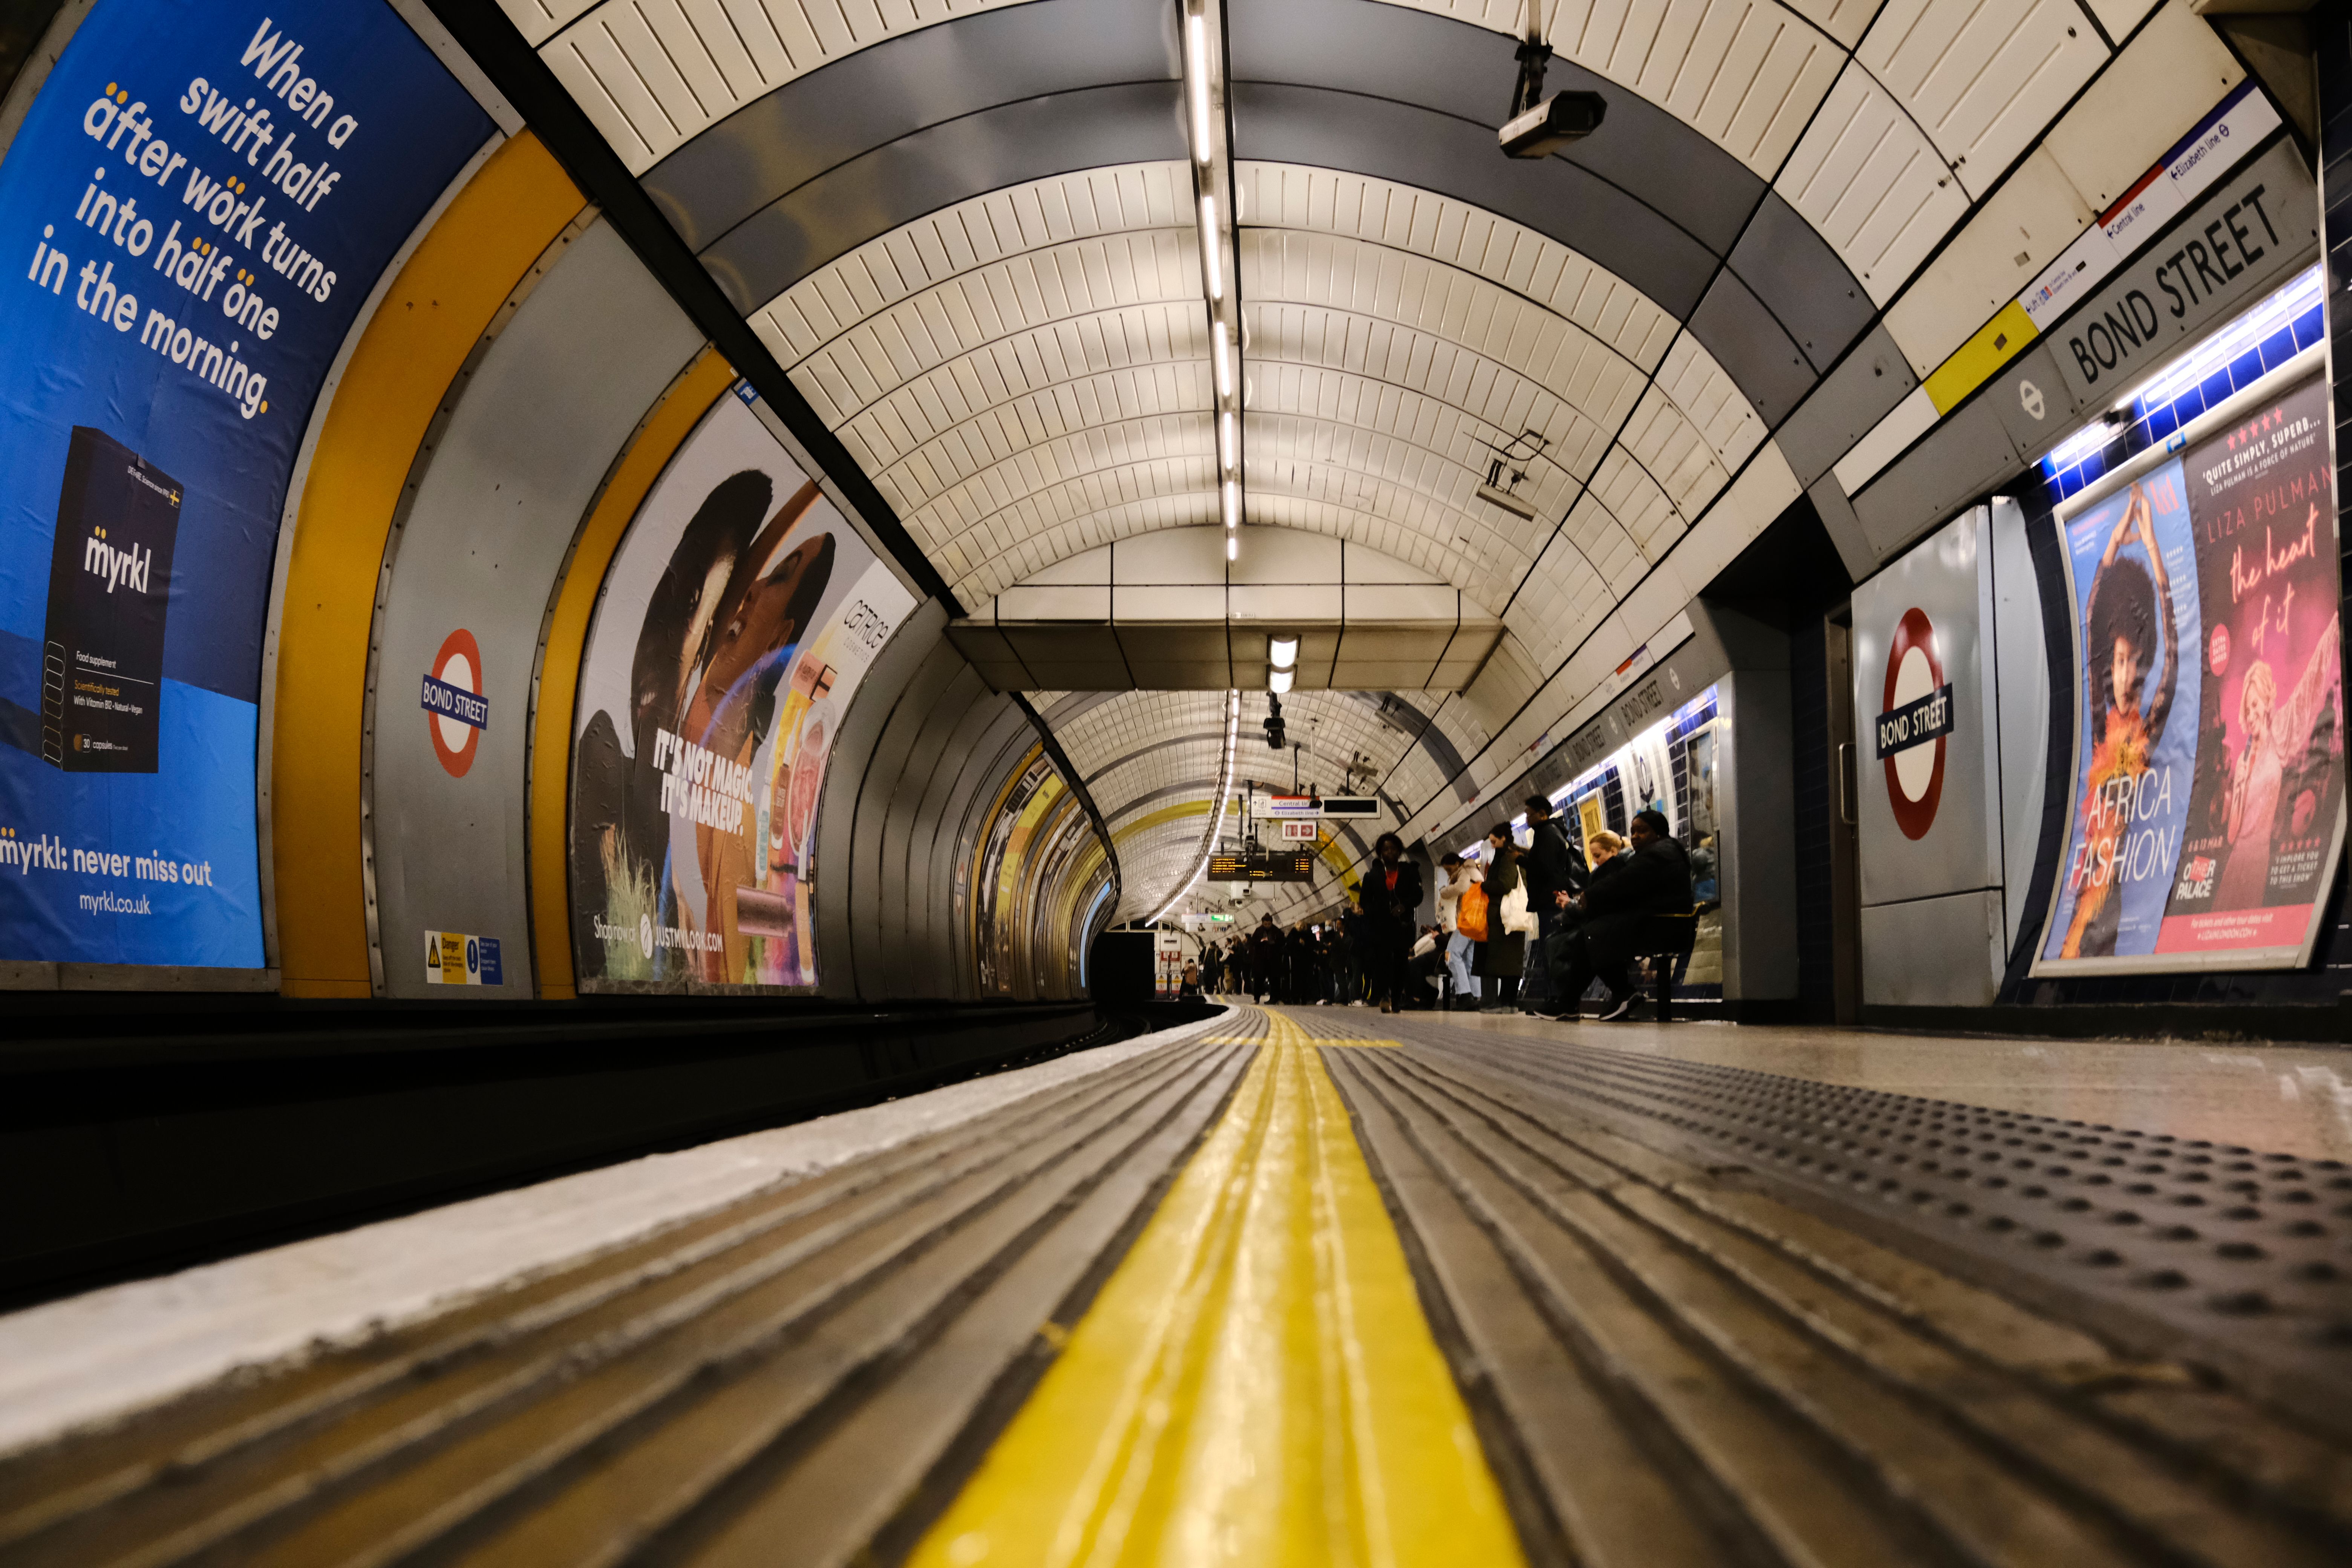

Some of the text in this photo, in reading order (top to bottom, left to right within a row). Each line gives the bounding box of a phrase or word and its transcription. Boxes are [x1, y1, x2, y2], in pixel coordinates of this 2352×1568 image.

[240, 17, 358, 149] When a
[180, 78, 341, 212] swift half
[2176, 135, 2220, 176] Elizabeth line
[75, 167, 153, 256] into
[2112, 203, 2145, 234] Central line
[262, 221, 337, 303] turns
[2069, 184, 2280, 384] BOND STREET
[28, 224, 268, 420] in the morning.
[2234, 439, 2270, 469] SIMPLY,
[2271, 417, 2320, 449] SUPERB...
[2211, 484, 2223, 496] LIZA
[2224, 470, 2245, 489] PULMAN
[2247, 466, 2252, 477] IS
[2254, 464, 2259, 473] A
[2260, 453, 2278, 470] FORCE
[2280, 447, 2288, 459] OF
[2207, 462, 2332, 543] LIZA PULMAN
[2230, 502, 2320, 604] the heart
[2252, 581, 2295, 654] of it
[77, 651, 116, 669] Food supplement
[74, 695, 85, 706] With
[86, 697, 104, 709] Vitamin
[115, 702, 129, 712] Natural
[131, 705, 142, 715] Vegan
[75, 680, 119, 696] Scientifically tested
[423, 682, 487, 723] BOND STREET
[84, 739, 90, 748] 30
[93, 741, 112, 751] capsules
[1881, 696, 1947, 749] BOND STREET
[654, 728, 683, 776] IT'S
[683, 741, 713, 784] NOT
[712, 755, 753, 804] MAGIC.
[660, 772, 689, 818] IT'S
[689, 785, 743, 836] MAKEUP.
[2086, 765, 2170, 832] AFRICA
[2068, 825, 2176, 890] FASHION
[2208, 835, 2223, 849] MAR
[2307, 850, 2319, 860] YOU
[74, 848, 130, 877] never
[136, 850, 178, 883] miss
[183, 861, 213, 887] out
[2176, 879, 2214, 900] PALACE
[2270, 876, 2278, 885] TO
[80, 891, 151, 916] myrkl.co.uk
[442, 937, 459, 952] Danger
[594, 914, 612, 946] Shop
[614, 926, 627, 941] now
[655, 926, 723, 952] JUSTMYLOOK.COM
